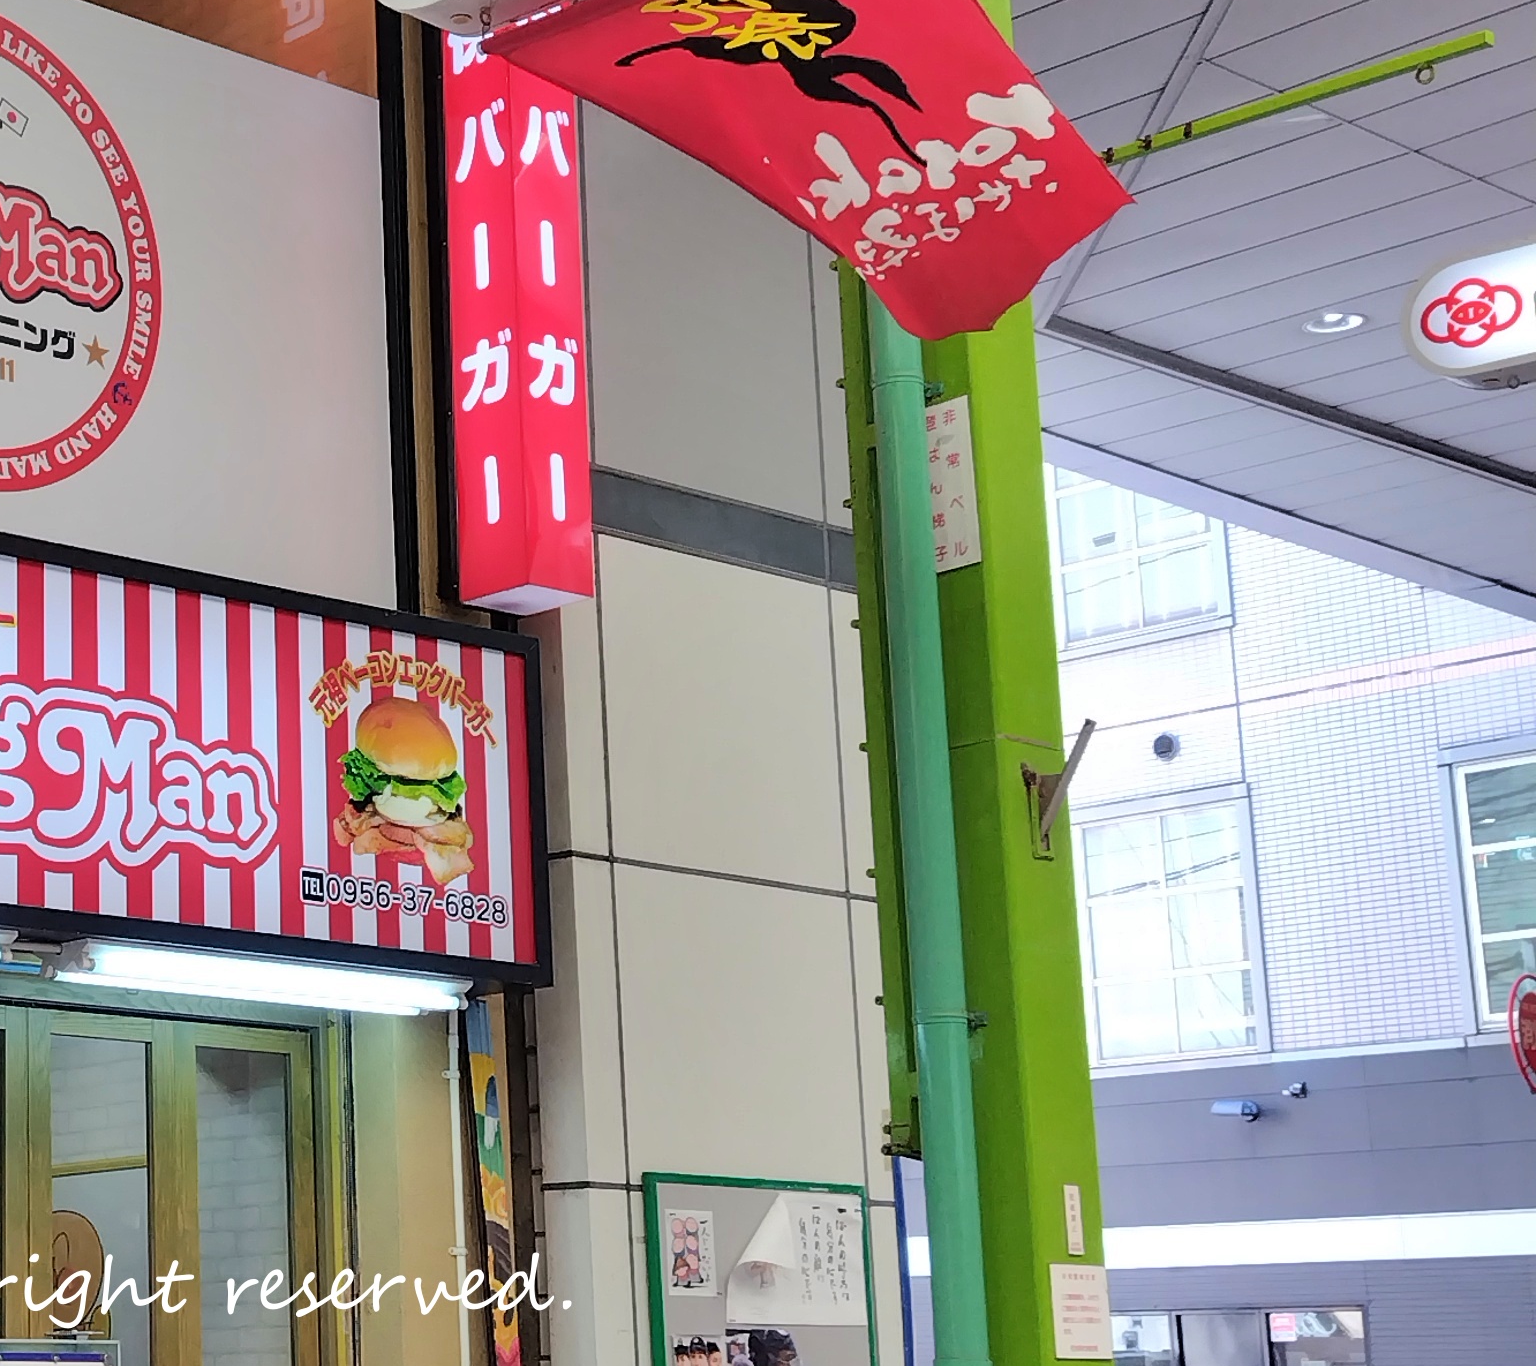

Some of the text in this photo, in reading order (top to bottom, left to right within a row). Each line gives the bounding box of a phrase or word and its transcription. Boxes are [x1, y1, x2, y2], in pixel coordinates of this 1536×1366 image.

[0, 29, 62, 88] LIKE
[62, 83, 95, 126] TO
[91, 127, 129, 187] SEE
[120, 190, 153, 283] YOUR
[120, 289, 154, 382] SMILE
[54, 401, 119, 467] HAND
[942, 409, 968, 557] 非常ベル
[307, 649, 499, 748] 元祖ベーコンエッグバーガー
[326, 877, 508, 925] 0956-37-6828
